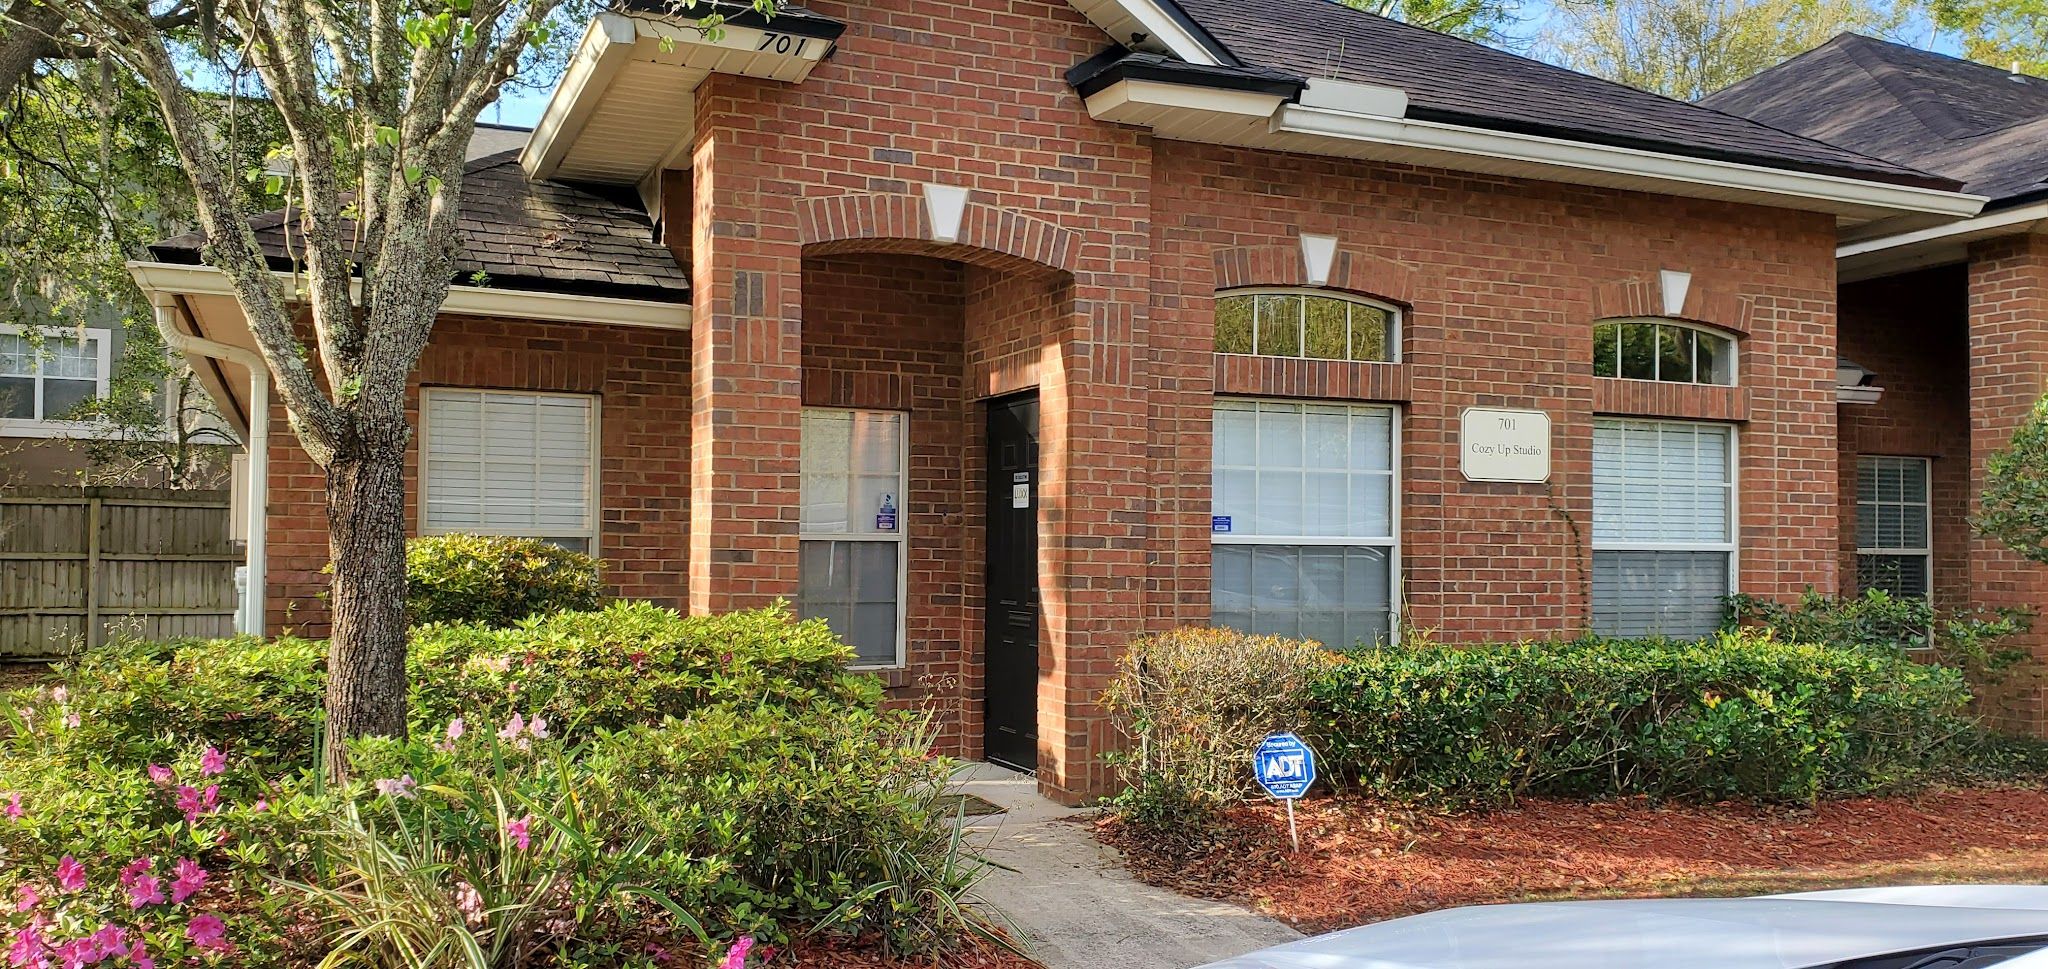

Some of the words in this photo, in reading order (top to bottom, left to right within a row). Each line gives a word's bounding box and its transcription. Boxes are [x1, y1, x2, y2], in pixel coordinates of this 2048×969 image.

[758, 32, 806, 56] 701
[1498, 417, 1516, 431] 701
[1471, 443, 1495, 457] Cozy
[1497, 443, 1511, 457] Up
[1513, 444, 1542, 456] Studio
[1266, 754, 1304, 778] ADT
